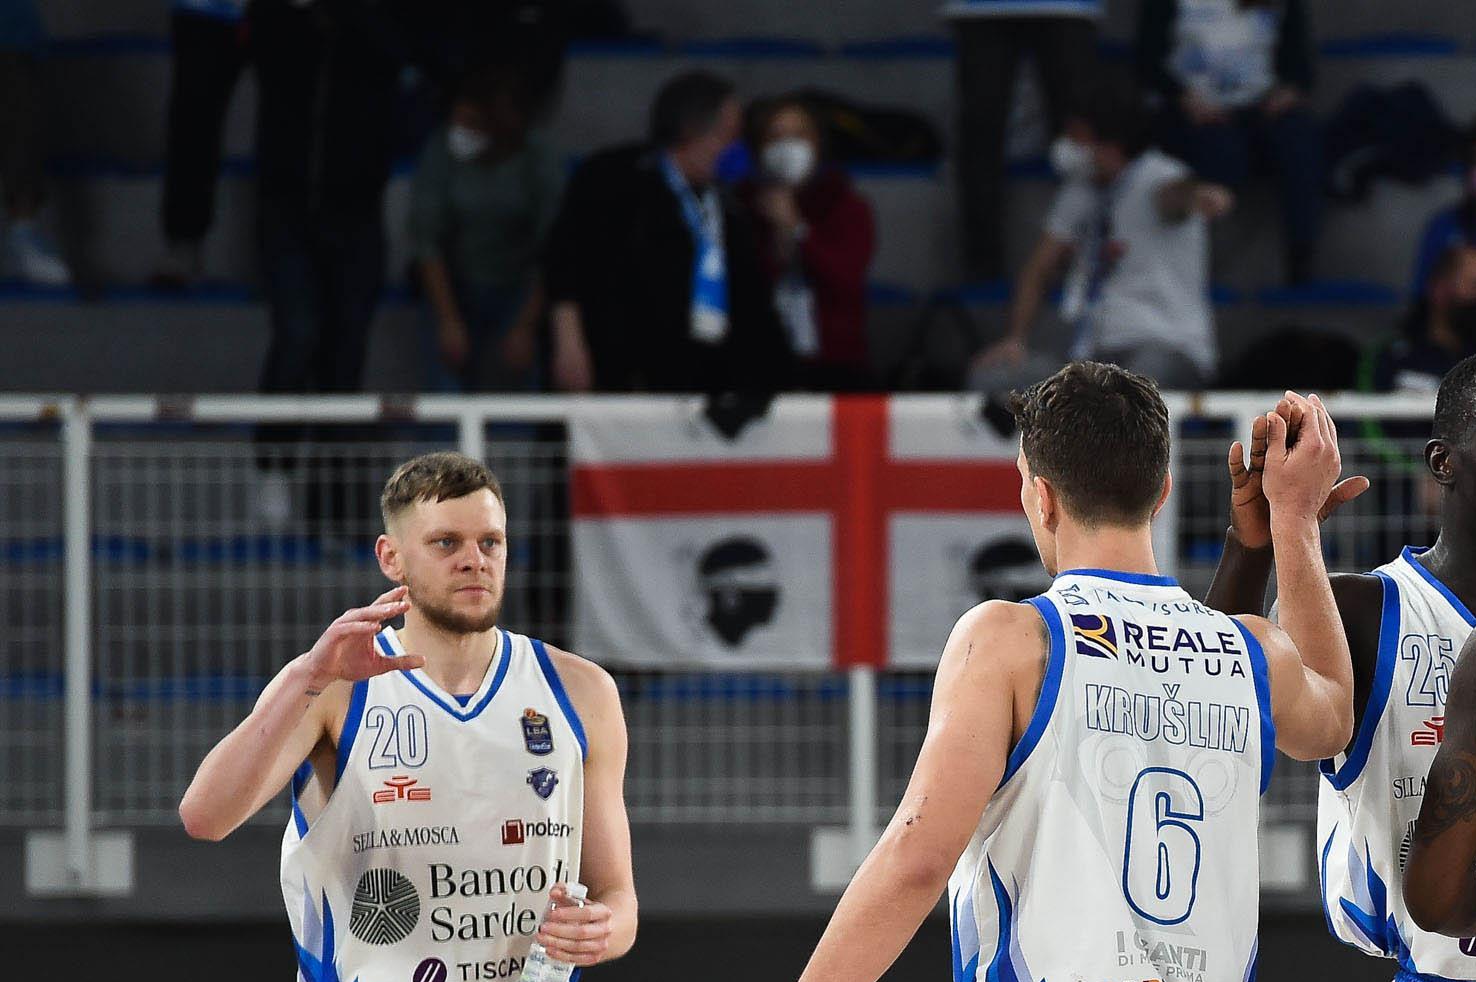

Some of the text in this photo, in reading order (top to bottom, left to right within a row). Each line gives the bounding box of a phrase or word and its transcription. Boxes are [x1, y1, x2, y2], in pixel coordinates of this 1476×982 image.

[1122, 619, 1242, 655] REALE
[1126, 648, 1246, 679] MUTUA
[1402, 634, 1454, 708] 25
[365, 704, 428, 769] 20
[1085, 683, 1250, 753] KRUŠLIN
[1122, 766, 1204, 926] 6
[429, 862, 547, 899] Banco
[430, 901, 543, 942] Sarde
[457, 957, 526, 982] TISCA
